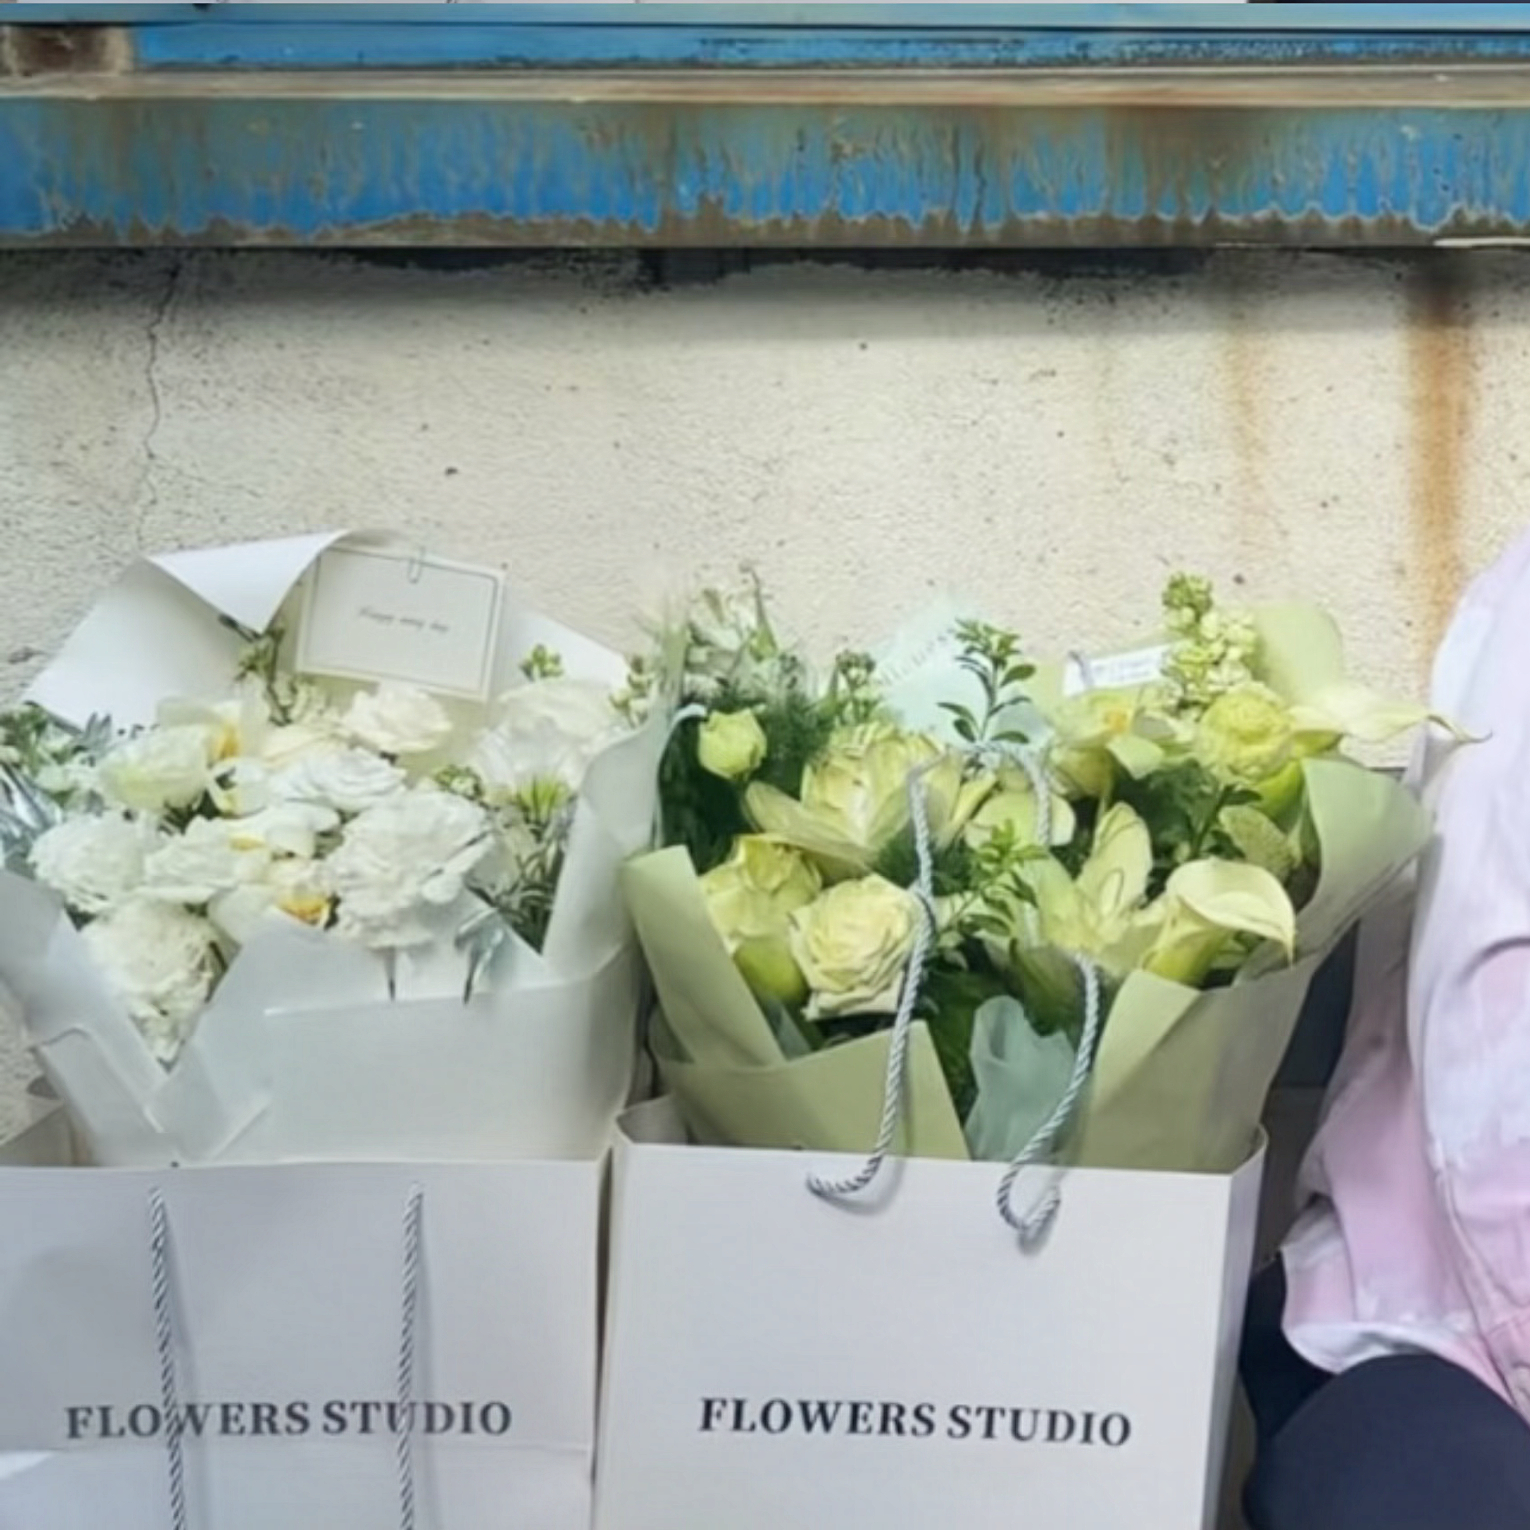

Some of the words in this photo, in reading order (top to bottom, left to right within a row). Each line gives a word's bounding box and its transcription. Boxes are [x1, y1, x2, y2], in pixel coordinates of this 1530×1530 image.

[64, 1400, 311, 1440] FLOWERS
[322, 1399, 513, 1437] STUDIO
[698, 1397, 936, 1438] FLOWERS
[946, 1404, 1132, 1447] STUDIO
